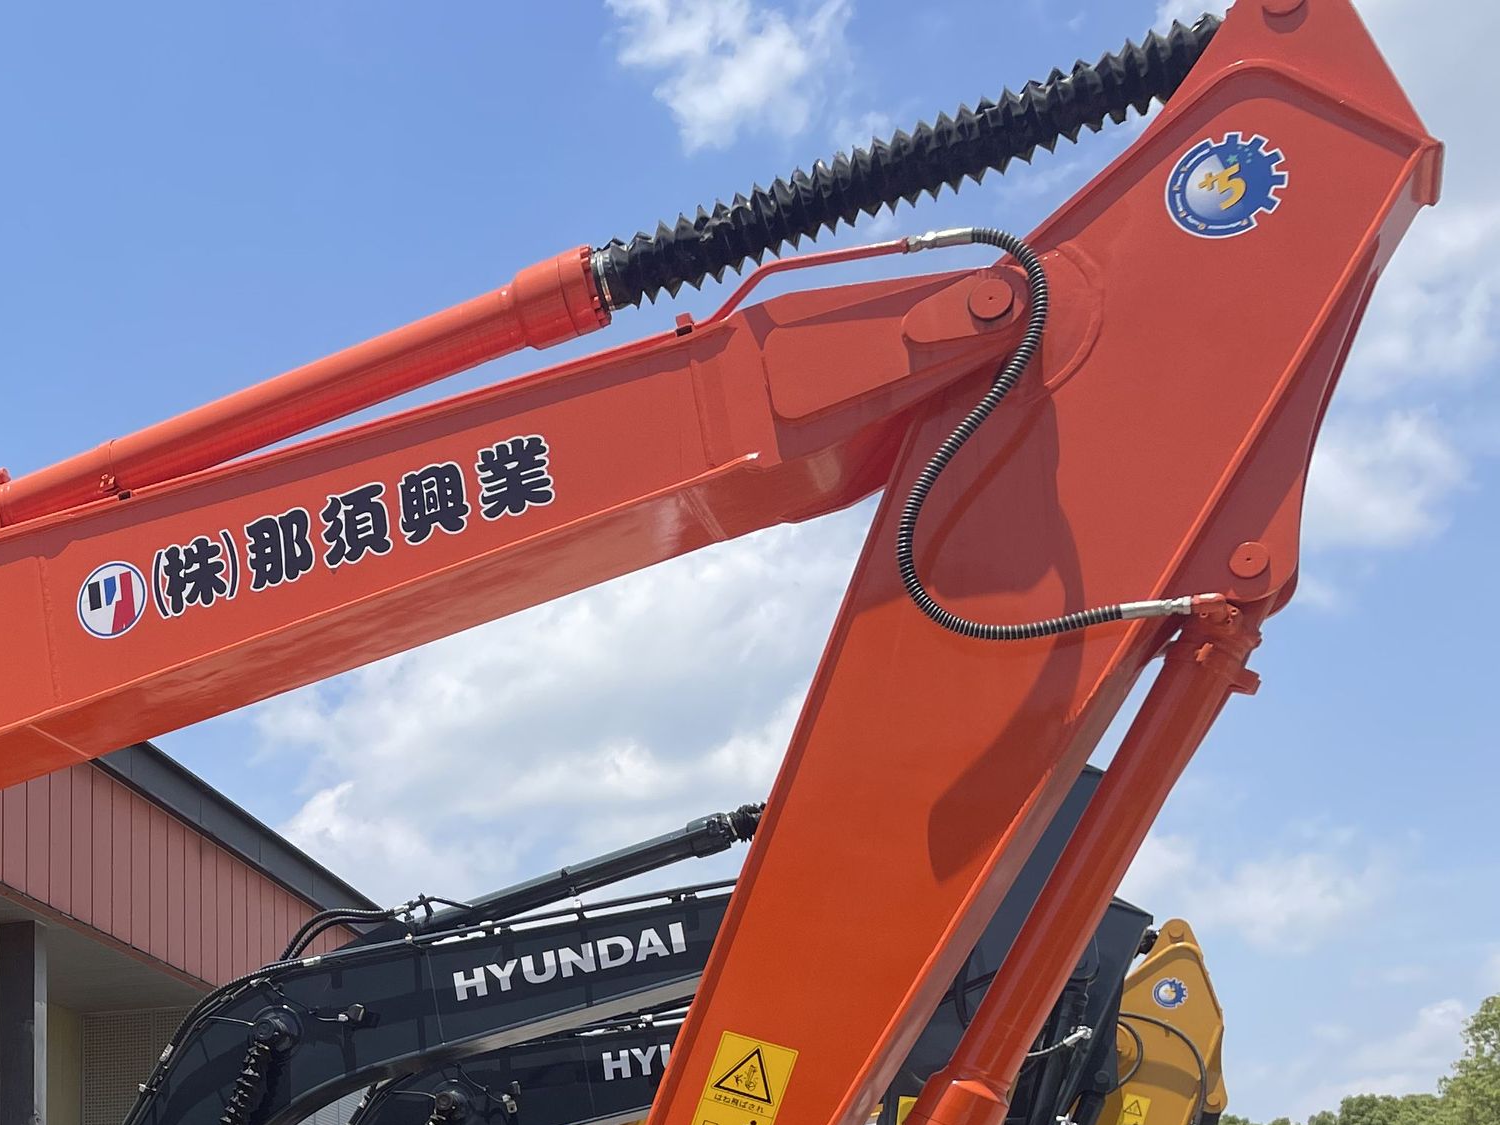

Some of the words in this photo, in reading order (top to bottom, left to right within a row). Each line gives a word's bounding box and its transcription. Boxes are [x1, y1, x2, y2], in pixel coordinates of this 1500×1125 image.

[452, 921, 687, 1001] HYUNDAI
[713, 1092, 765, 1114] はね飛ばされ
